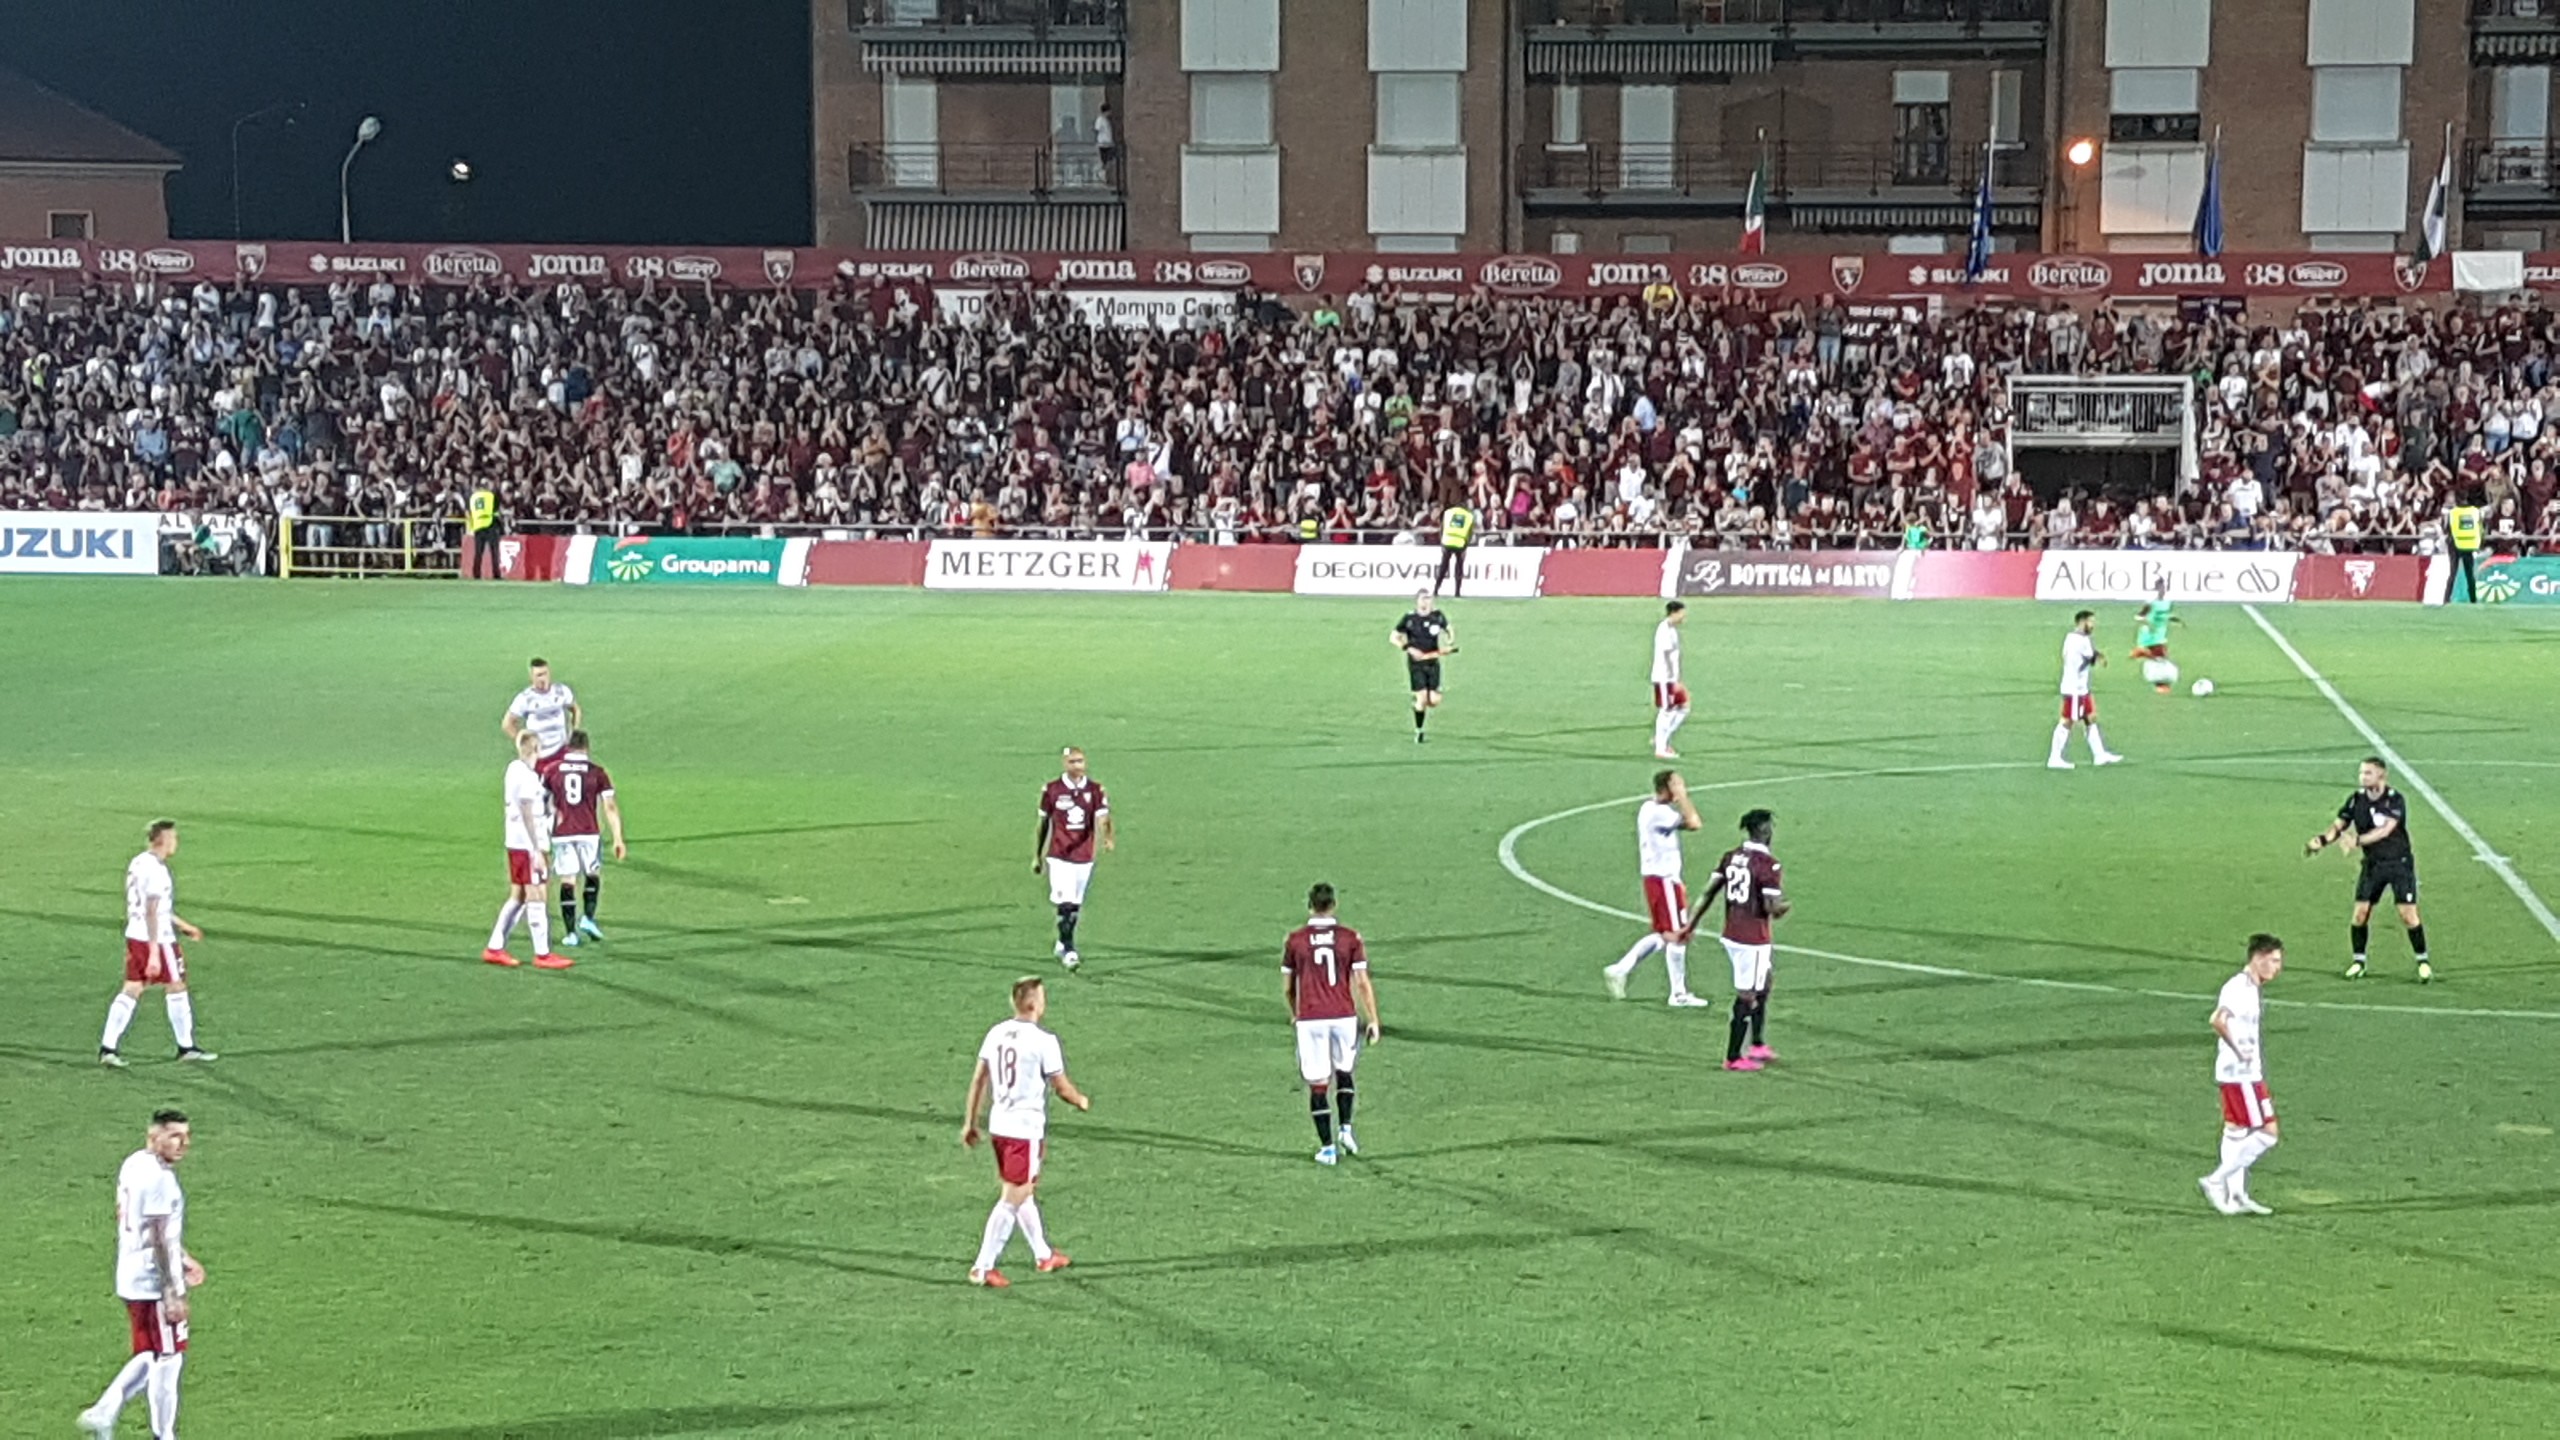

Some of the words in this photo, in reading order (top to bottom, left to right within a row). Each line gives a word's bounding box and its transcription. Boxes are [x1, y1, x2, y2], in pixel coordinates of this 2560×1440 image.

[332, 256, 406, 271] SUZUKI
[955, 259, 1026, 279] Beretta
[1153, 261, 1193, 283] 38
[1388, 266, 1463, 282] SUZUKI
[1486, 263, 1556, 283] Beretta
[2034, 264, 2106, 284] Beretta
[661, 554, 770, 575] Groupama
[941, 551, 1122, 578] METZGER
[1730, 564, 1812, 586] BOTTEGA
[1833, 565, 1891, 586] SARTO
[2051, 560, 2131, 591] Aldo
[564, 772, 582, 805] 9
[1725, 865, 1751, 903] 23
[1314, 946, 1337, 987] 7
[997, 1044, 1018, 1089] 18
